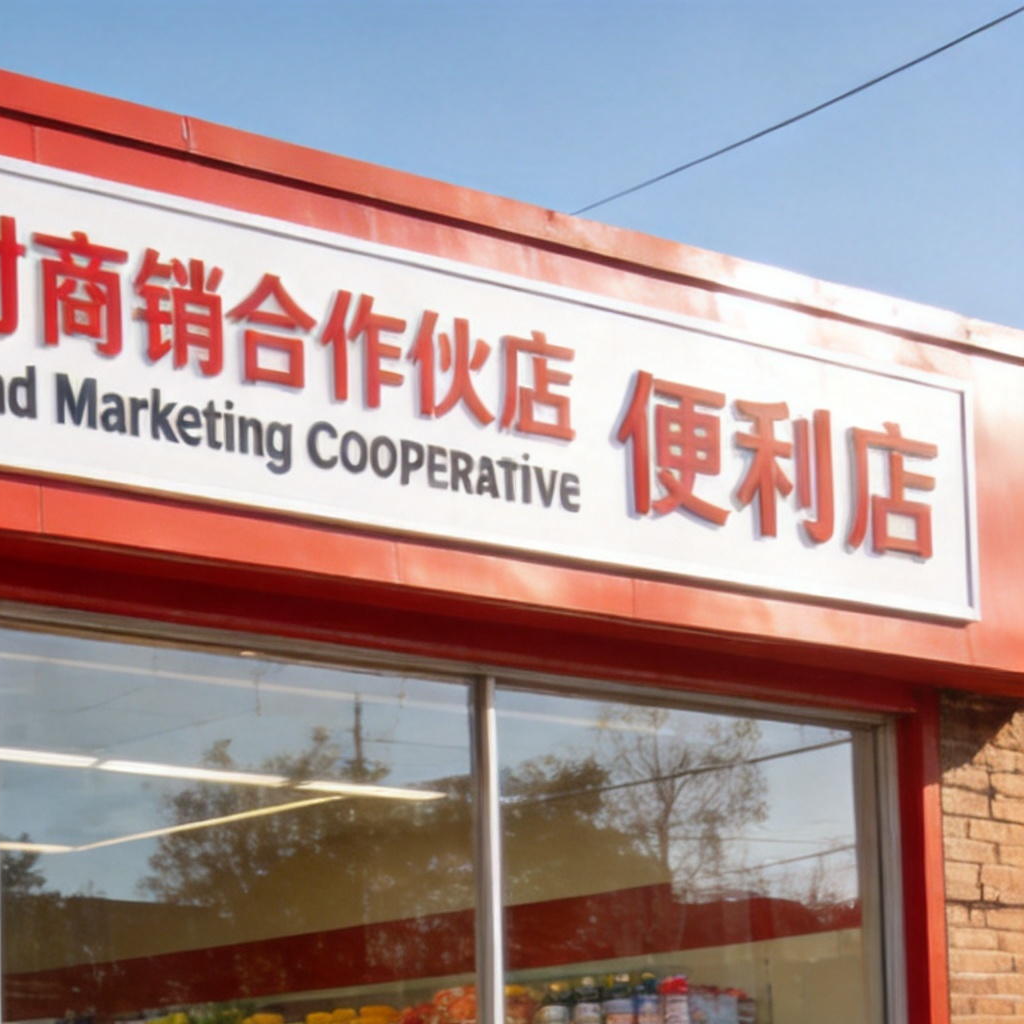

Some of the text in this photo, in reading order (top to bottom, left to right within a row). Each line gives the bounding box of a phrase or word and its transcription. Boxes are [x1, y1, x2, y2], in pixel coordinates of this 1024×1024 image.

[55, 372, 293, 474] Marketing
[616, 369, 939, 559] 便利店
